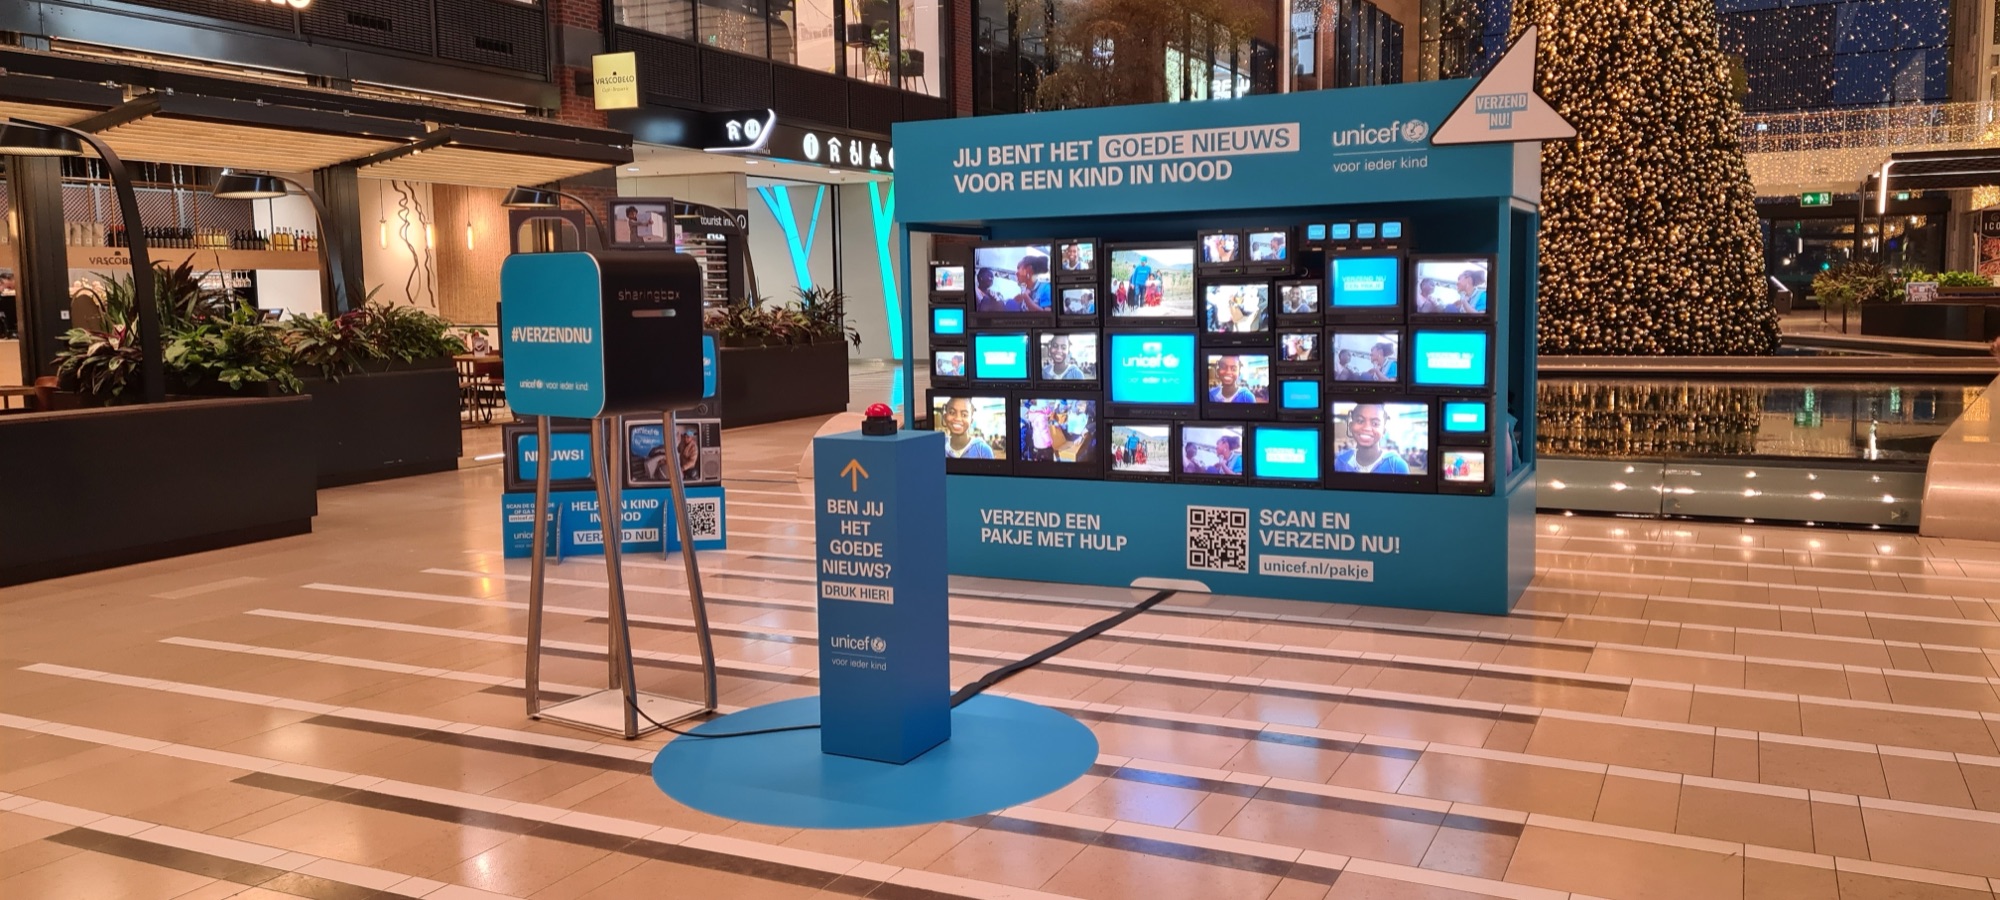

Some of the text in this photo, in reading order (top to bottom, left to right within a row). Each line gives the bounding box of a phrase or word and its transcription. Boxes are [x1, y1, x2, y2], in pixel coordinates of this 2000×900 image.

[1476, 94, 1527, 111] VERZEND
[1490, 113, 1510, 127] NU!
[1332, 120, 1400, 147] unicef
[953, 127, 1290, 168] JIJ BENT HET GOEDE NIEUWS
[1333, 155, 1428, 173] voor ieder kind
[953, 160, 1233, 193] VOOR EEN KIND IN NOOD
[700, 215, 721, 226] tourist
[89, 257, 132, 265] VASCOB
[618, 288, 680, 303] sharingbox
[511, 326, 593, 344] #VERZENDNU
[546, 382, 559, 390] voor
[575, 382, 588, 391] kind
[525, 449, 584, 462] NIUWS!
[630, 499, 659, 510] KIND
[827, 499, 884, 517] BEN JIJ
[840, 520, 871, 536] HET
[980, 508, 1101, 530] VERZEND EEN
[1259, 509, 1350, 530] SCAN EN
[635, 530, 657, 541] NU!
[981, 527, 1128, 552] PAKJE MET HULP
[1259, 529, 1401, 555] VERZEND NU!
[829, 539, 883, 558] GOEDE
[822, 559, 892, 579] NIEUWS?
[1263, 559, 1370, 580] unicef.nl/pakje
[825, 584, 890, 602] DRUK HIER!
[831, 635, 870, 651] unicef
[831, 658, 887, 671] voor ieder kind
